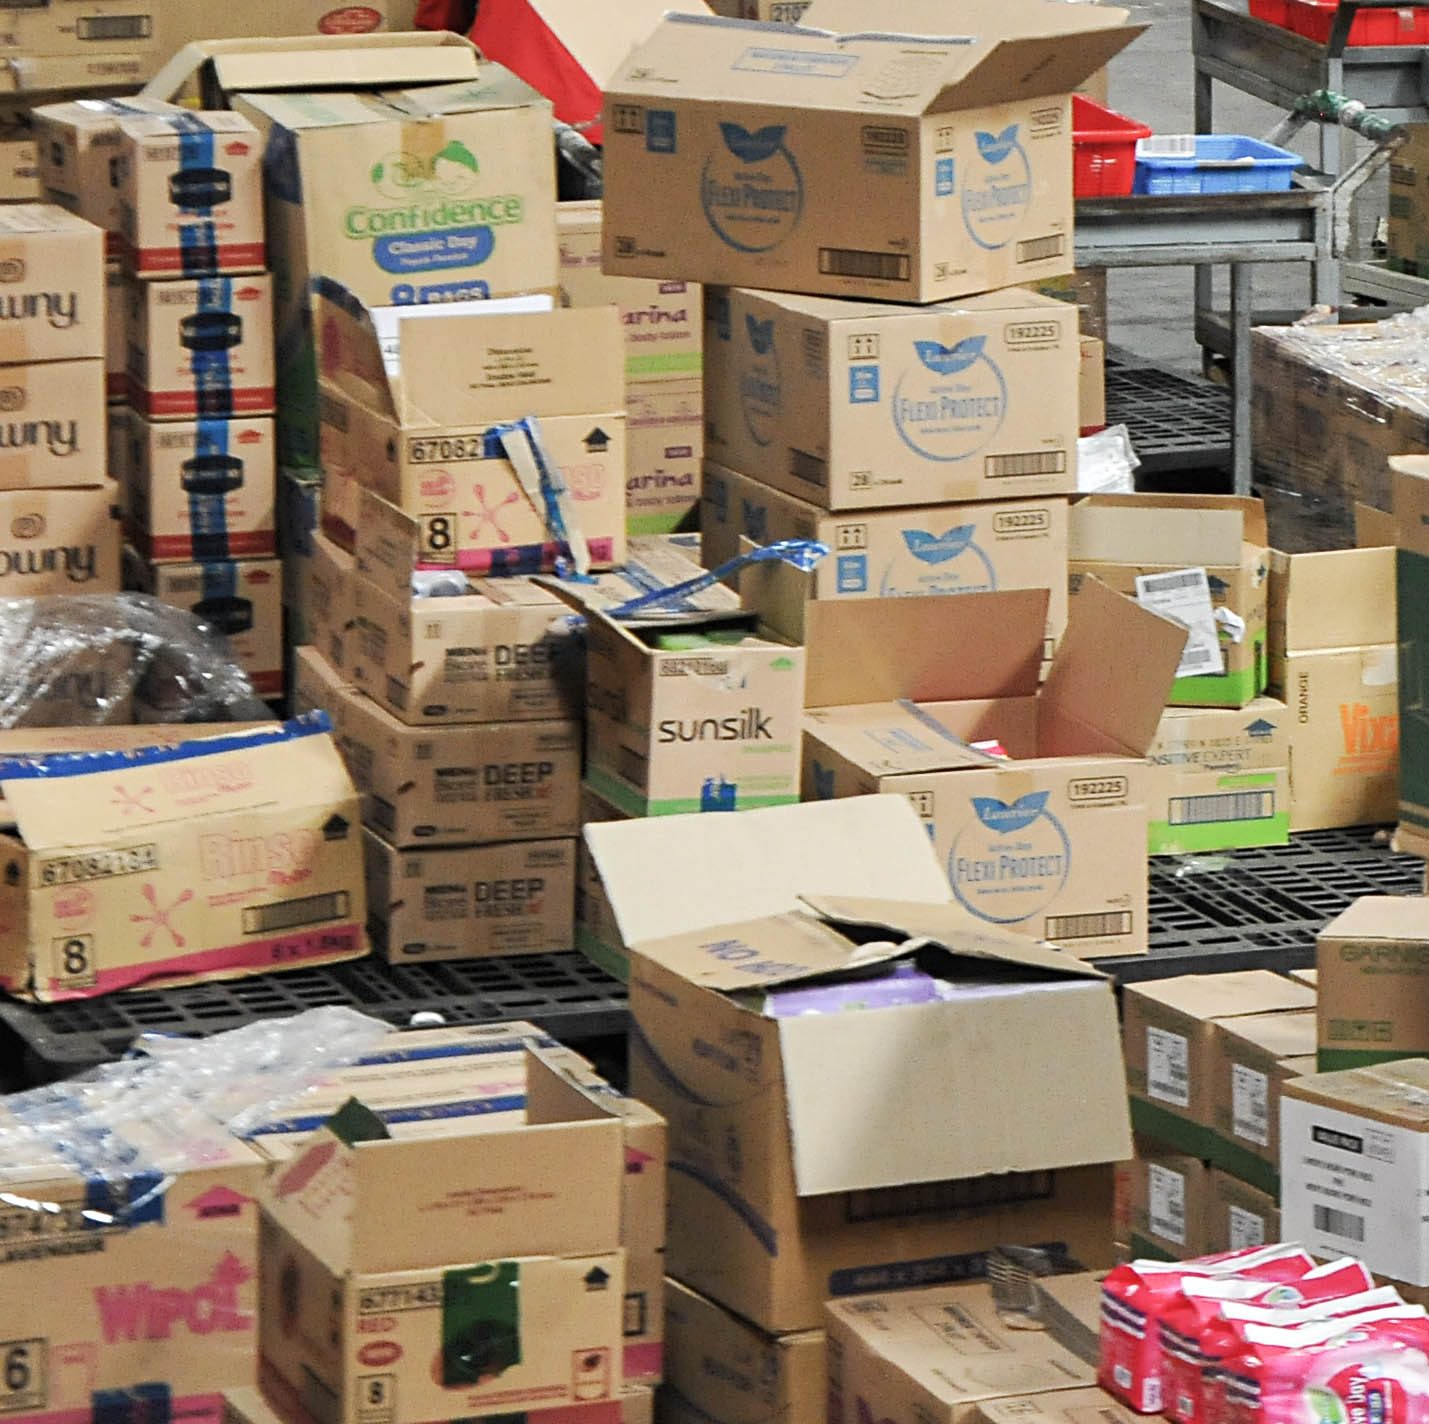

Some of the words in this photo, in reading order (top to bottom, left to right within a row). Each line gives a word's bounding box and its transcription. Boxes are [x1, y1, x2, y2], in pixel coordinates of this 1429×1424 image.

[344, 194, 524, 240] Confidence
[1008, 323, 1056, 342] 192225
[940, 395, 1000, 419] PROTECT
[411, 439, 479, 460] 67082
[429, 518, 451, 550] 8
[1298, 671, 1310, 725] ORANGE
[657, 707, 774, 744] sunsilk
[484, 761, 554, 786] DEEP
[1072, 779, 1123, 796] 192225
[998, 852, 1067, 882] PROTECT
[474, 877, 545, 902] DEEP
[63, 938, 88, 975] 8
[4, 1346, 31, 1391] 6
